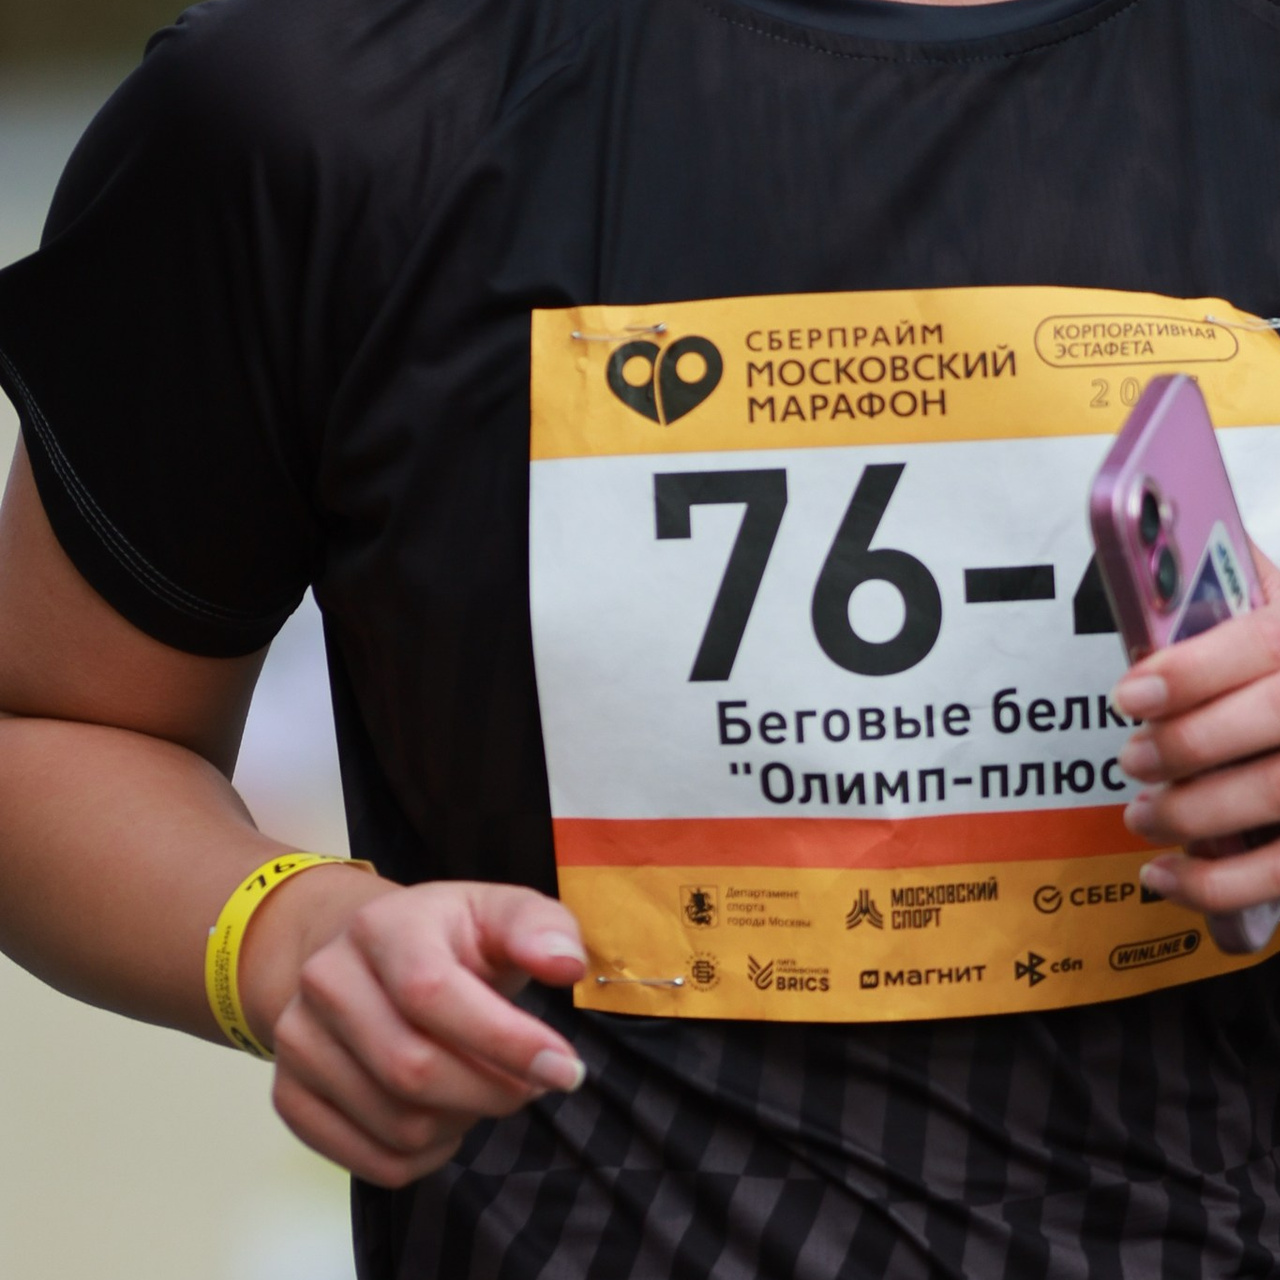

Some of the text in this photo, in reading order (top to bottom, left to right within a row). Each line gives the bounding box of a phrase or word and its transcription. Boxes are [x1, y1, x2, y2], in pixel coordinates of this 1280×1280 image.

[745, 320, 944, 352] СБЕРПРАЙМ
[1053, 322, 1216, 341] КОРПОРАТИВНАЯ
[1054, 340, 1154, 359] ЭСТАФЕТА
[746, 344, 1017, 388] МОСКОВСКИЙ
[748, 389, 947, 423] МАРАФОН
[716, 687, 1143, 746] Беговые белк
[891, 876, 998, 907] МОСКОВСКИЙ
[1069, 882, 1135, 907] СБЕР
[892, 907, 942, 930] СПОРТ
[1117, 938, 1182, 965] WINLINE
[776, 976, 830, 992] BRICS
